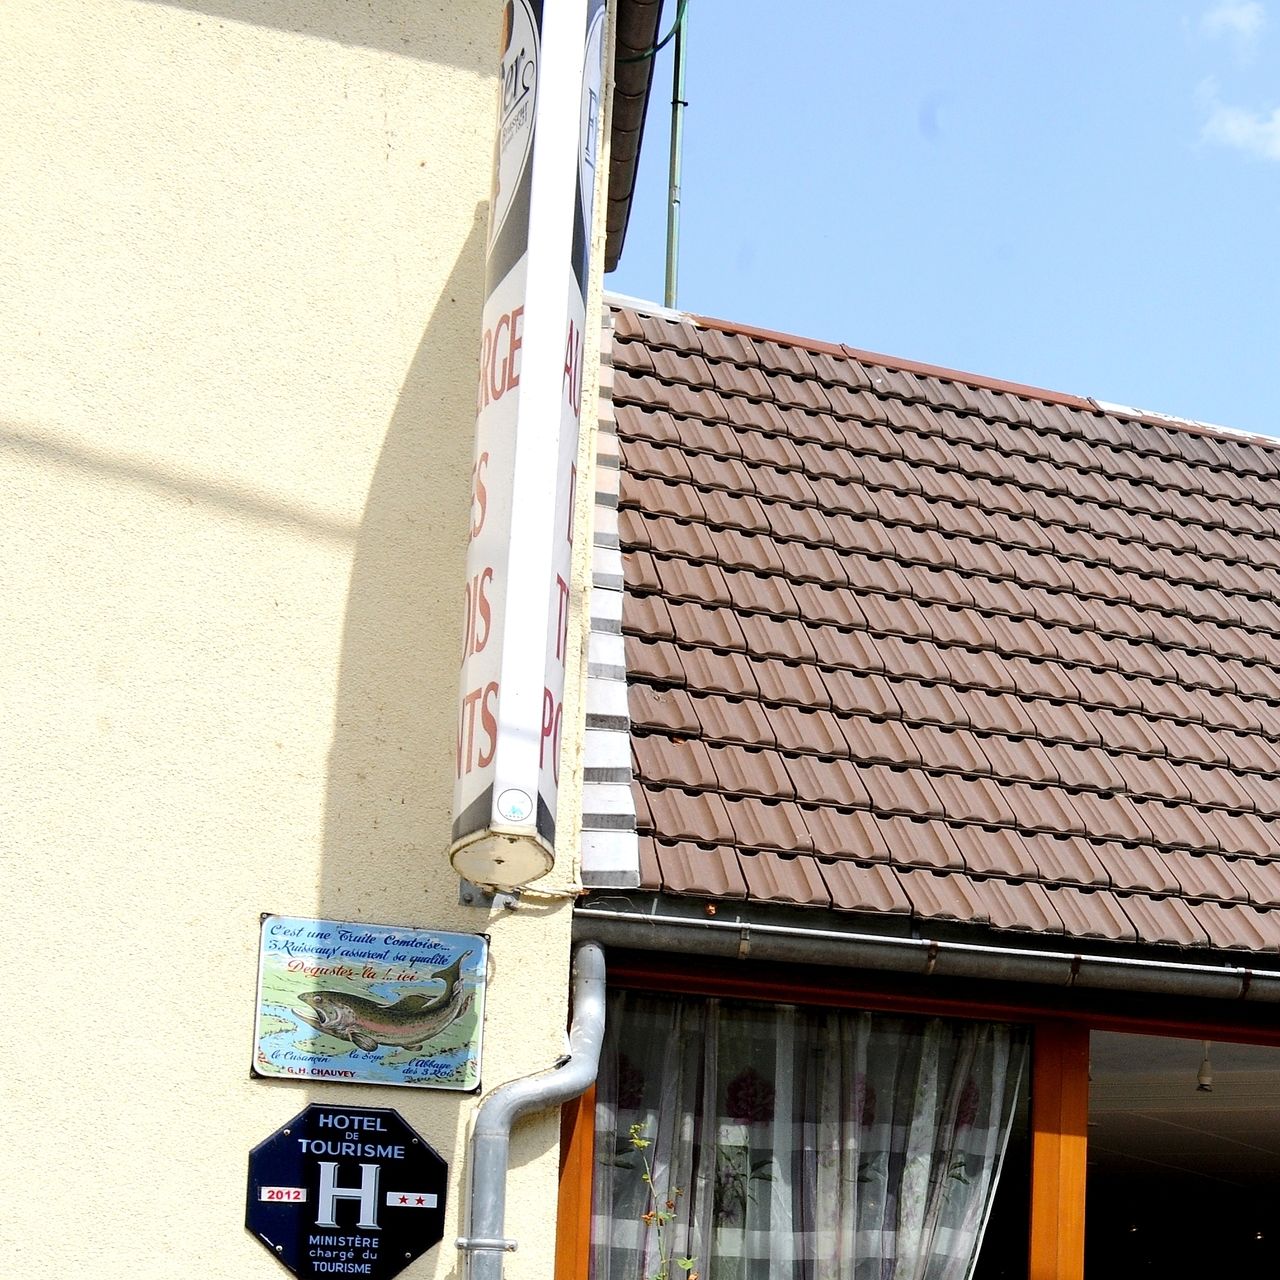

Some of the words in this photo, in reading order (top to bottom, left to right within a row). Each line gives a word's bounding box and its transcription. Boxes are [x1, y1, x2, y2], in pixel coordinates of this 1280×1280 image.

[270, 924, 304, 938] C'est
[306, 930, 331, 940] une
[338, 929, 377, 944] Truite
[340, 948, 390, 961] assurent
[392, 951, 407, 962] sa
[409, 953, 452, 968] qualité
[396, 970, 419, 982] ici
[349, 1050, 360, 1059] la
[311, 1068, 356, 1078] CHAUVEY
[402, 1067, 418, 1075] des
[430, 1069, 455, 1079] Rois
[319, 1114, 387, 1132] HOTEL
[345, 1132, 359, 1140] DE
[298, 1139, 405, 1159] TOURISME
[267, 1190, 301, 1200] 2012
[314, 1161, 382, 1230] H
[309, 1235, 379, 1248] MINISTÈRE
[309, 1248, 355, 1261] chargé
[363, 1250, 377, 1260] du
[312, 1261, 371, 1274] TOURISME
